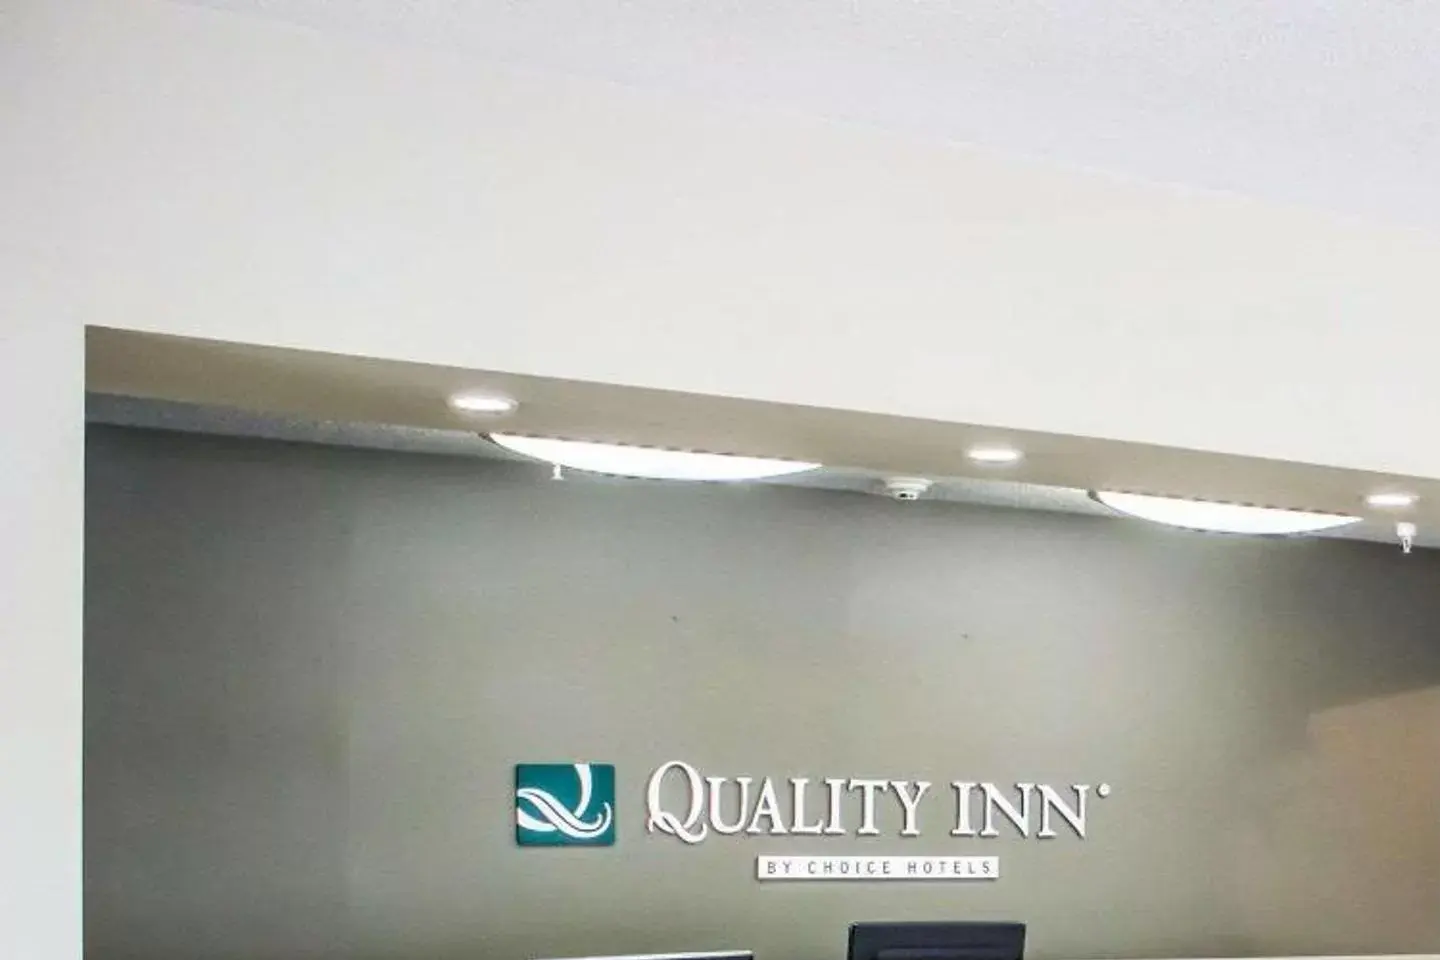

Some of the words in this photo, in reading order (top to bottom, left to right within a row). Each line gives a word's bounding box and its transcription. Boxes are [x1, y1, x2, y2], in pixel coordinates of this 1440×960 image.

[647, 761, 930, 843] QUALITY
[766, 862, 793, 876] BY
[808, 861, 893, 876] CHOICE
[907, 861, 993, 876] HOTELS
